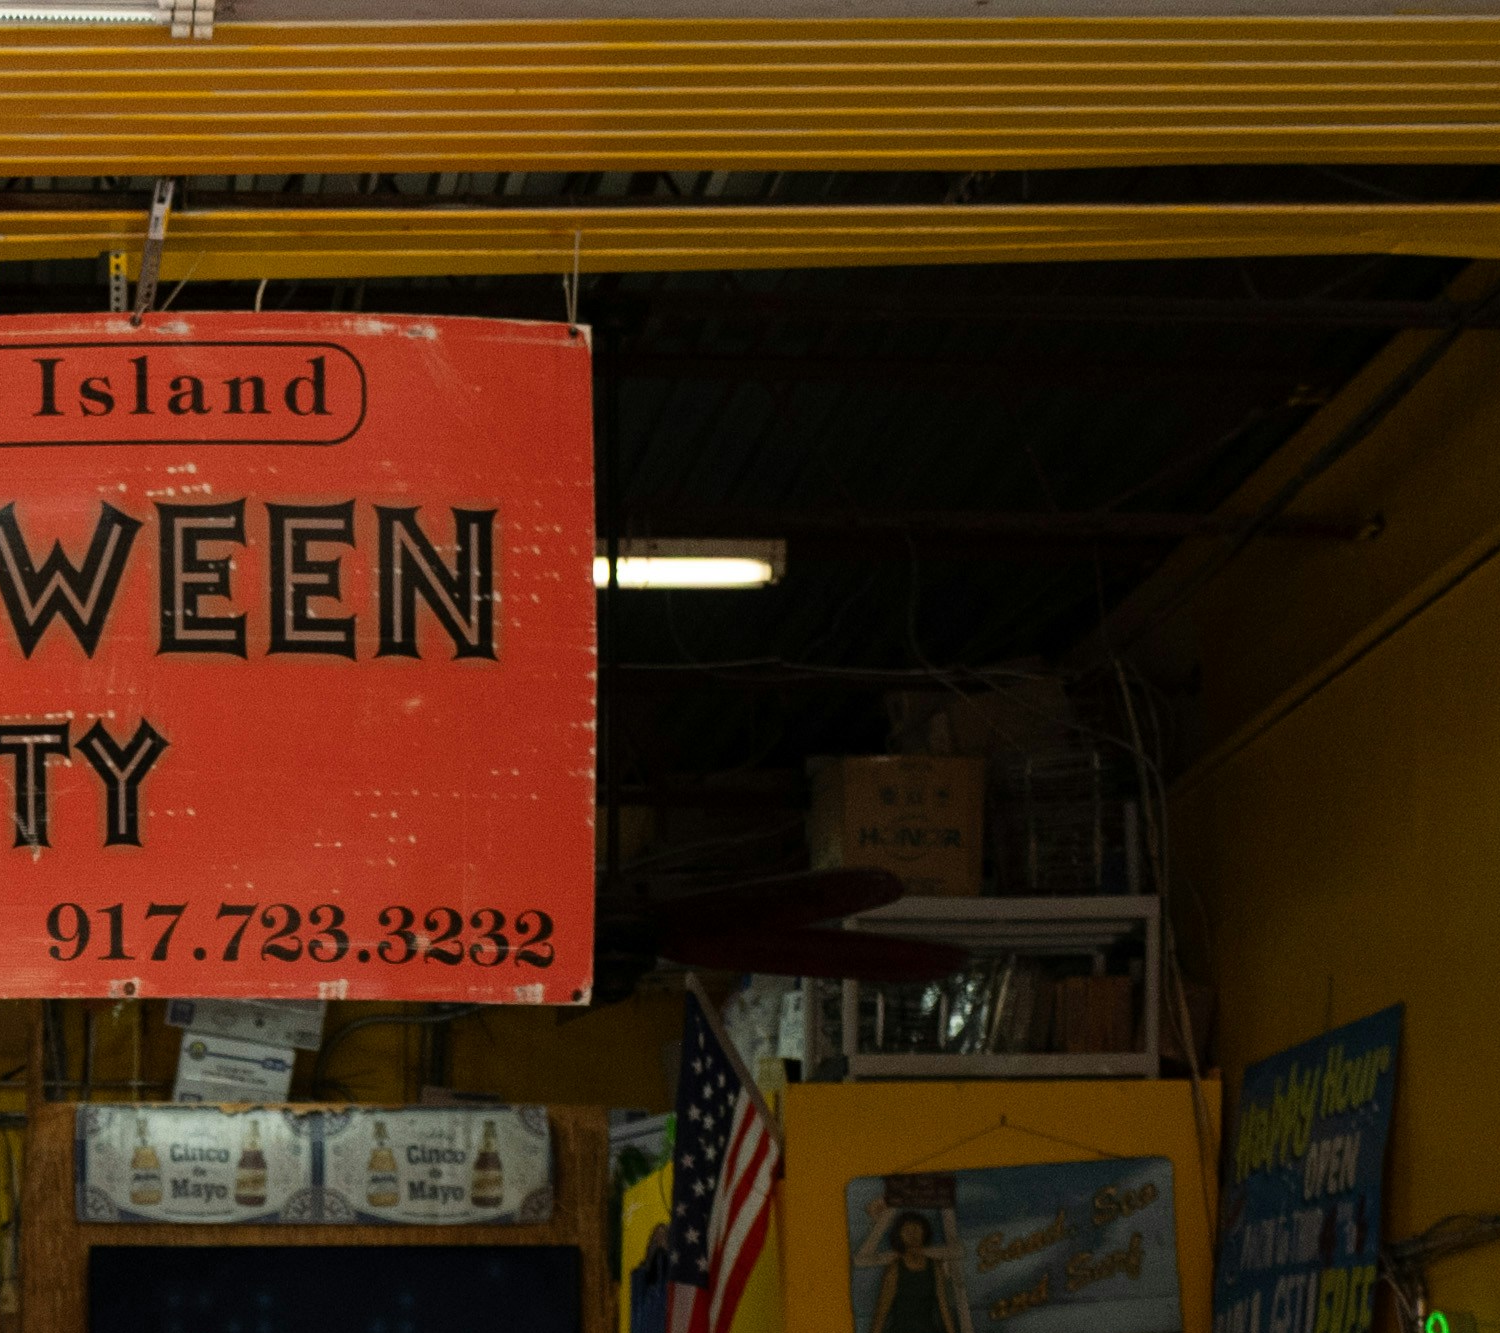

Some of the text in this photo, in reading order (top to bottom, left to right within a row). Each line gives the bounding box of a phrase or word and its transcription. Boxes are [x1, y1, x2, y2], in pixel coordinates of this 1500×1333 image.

[33, 355, 335, 421] Island
[45, 900, 557, 968] 917.723.3232
[1236, 1045, 1391, 1180] Happy Hour
[169, 1142, 230, 1165] Cinco
[406, 1143, 466, 1166] Cinco
[1304, 1131, 1362, 1200] OPEN
[170, 1178, 229, 1204] Mayo
[407, 1180, 465, 1205] Mayo
[1067, 1232, 1143, 1292] Surf
